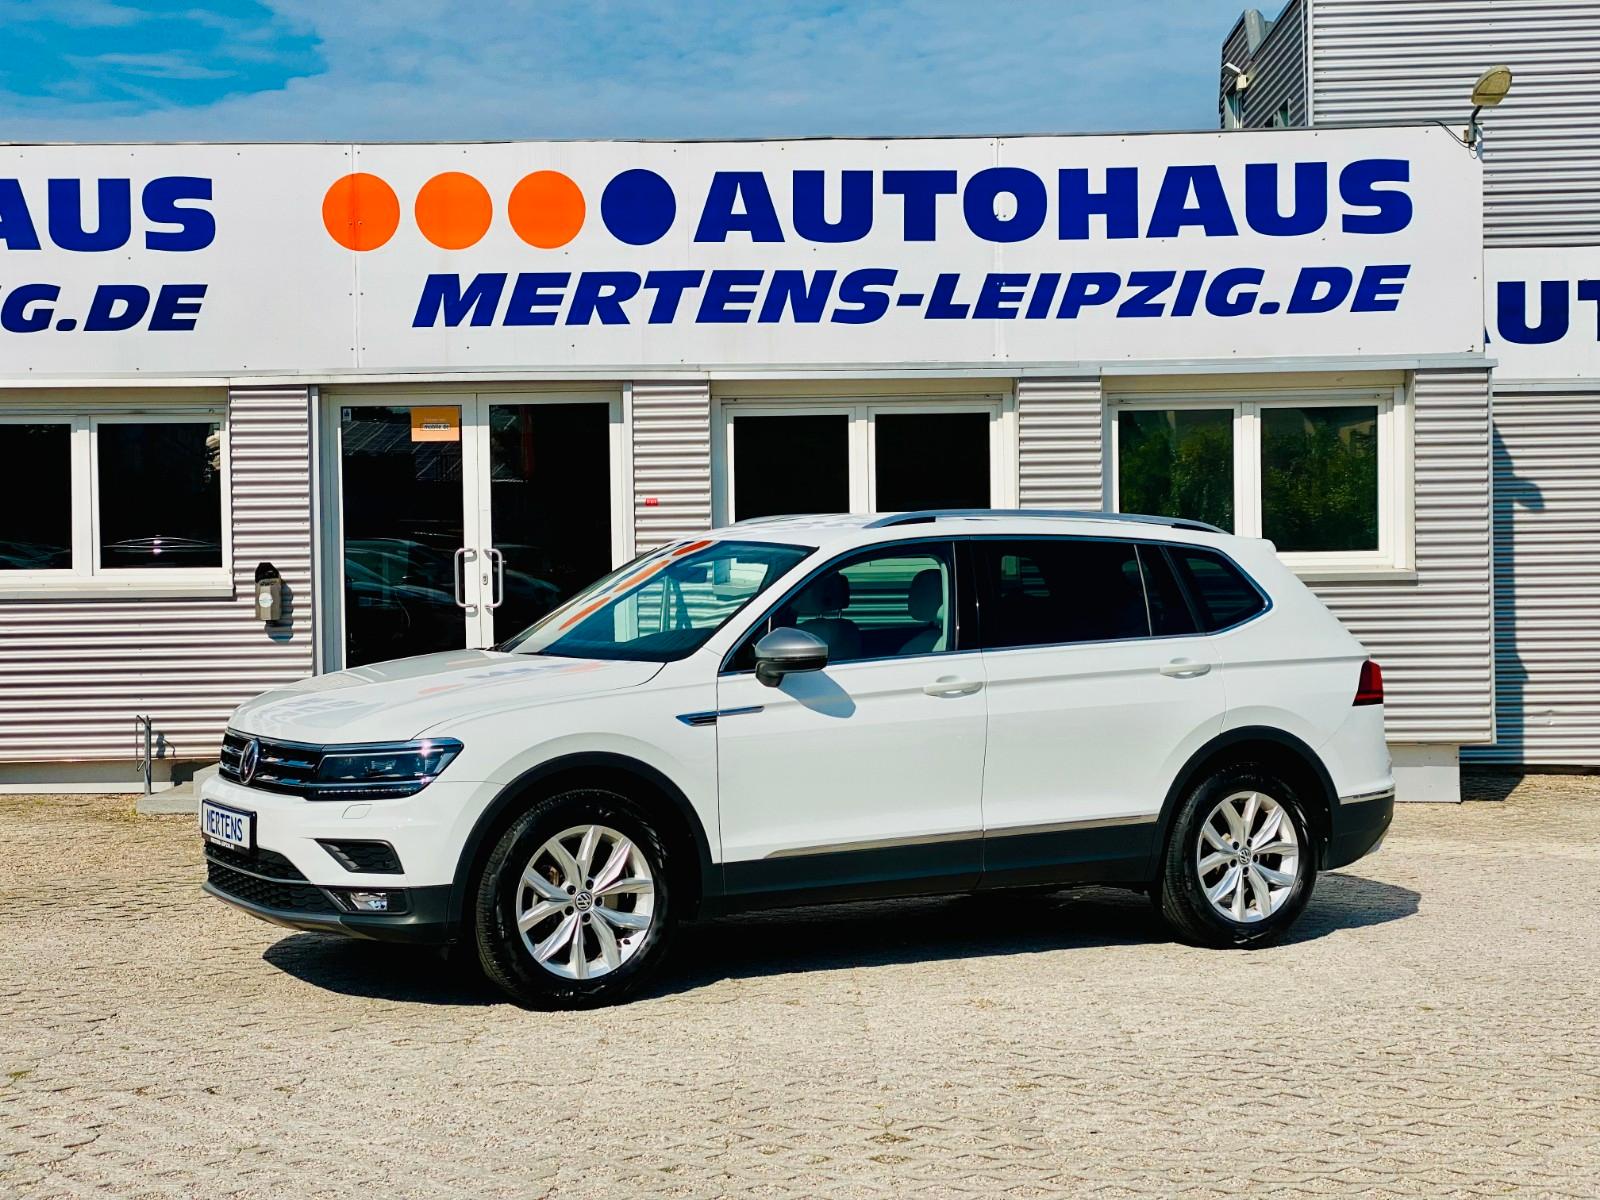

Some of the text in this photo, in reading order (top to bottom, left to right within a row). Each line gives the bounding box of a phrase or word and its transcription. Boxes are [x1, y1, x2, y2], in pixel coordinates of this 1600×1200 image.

[695, 159, 1412, 245] AUTOHAUS
[0, 284, 206, 333] G.DE
[413, 265, 1410, 327] MERTENS-LEIPZIG.DE
[206, 808, 243, 842] MERTENS
